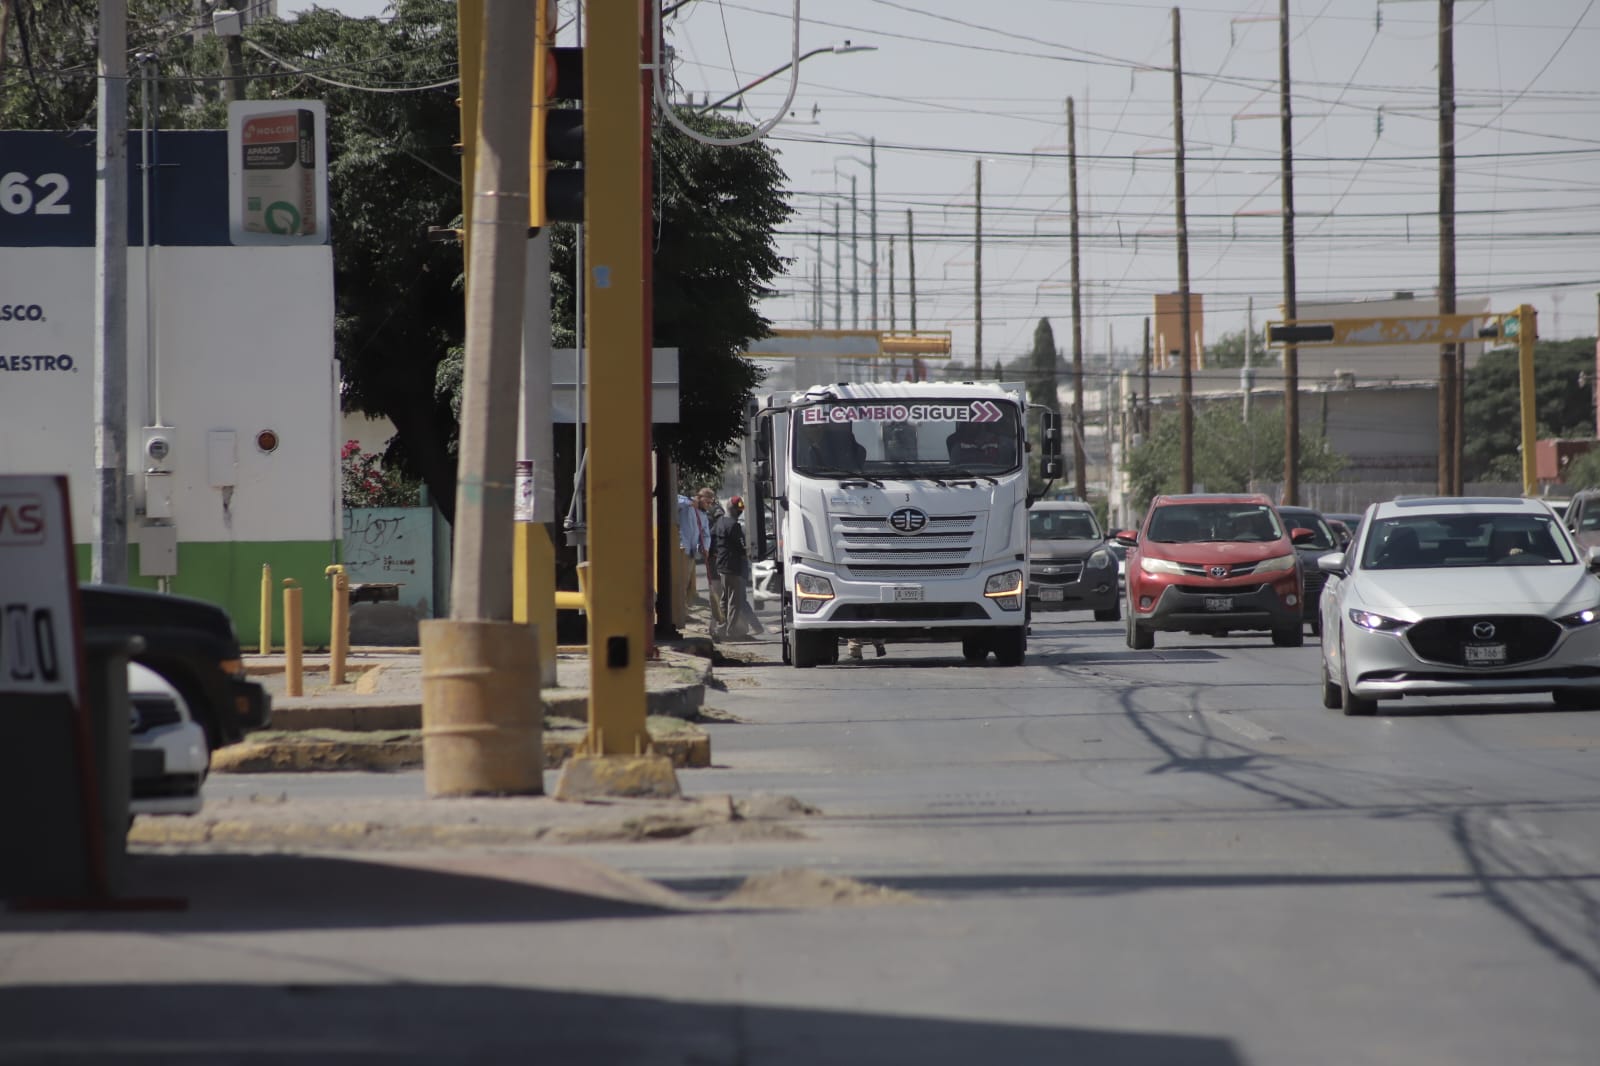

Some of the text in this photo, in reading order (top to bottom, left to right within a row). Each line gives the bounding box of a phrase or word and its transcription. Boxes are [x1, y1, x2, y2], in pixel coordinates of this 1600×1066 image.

[247, 146, 281, 155] APASCO
[0, 171, 71, 215] 62
[0, 304, 43, 321] SCO
[804, 407, 968, 422] EL CAMBIO SIGUE
